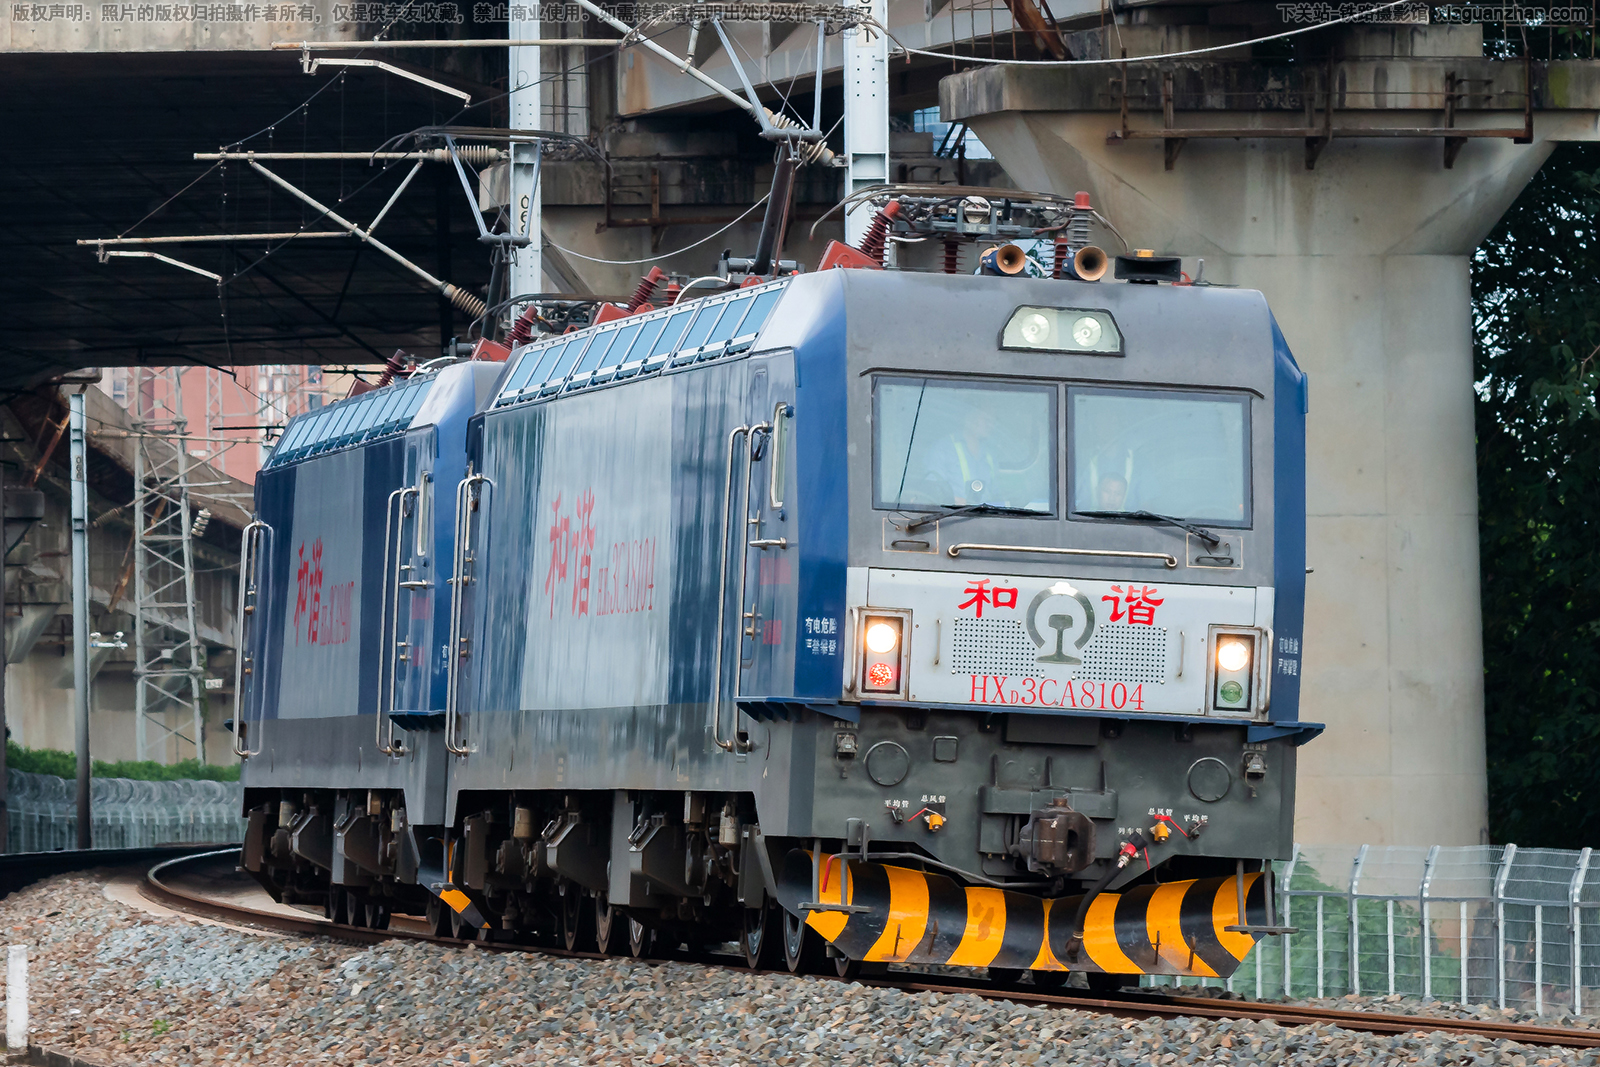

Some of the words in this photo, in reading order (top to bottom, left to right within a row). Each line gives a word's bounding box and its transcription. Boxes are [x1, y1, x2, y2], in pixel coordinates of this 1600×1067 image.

[544, 486, 597, 620] 和谐
[293, 536, 324, 646] 和谐
[805, 616, 838, 634] 有电危险
[968, 675, 1145, 711] HXD3CA8104
[884, 799, 910, 814] 平均管
[920, 794, 947, 808] 总风管
[1147, 807, 1174, 823] 总风管
[1183, 814, 1209, 829] 平均管
[1117, 827, 1143, 844] 列车管
